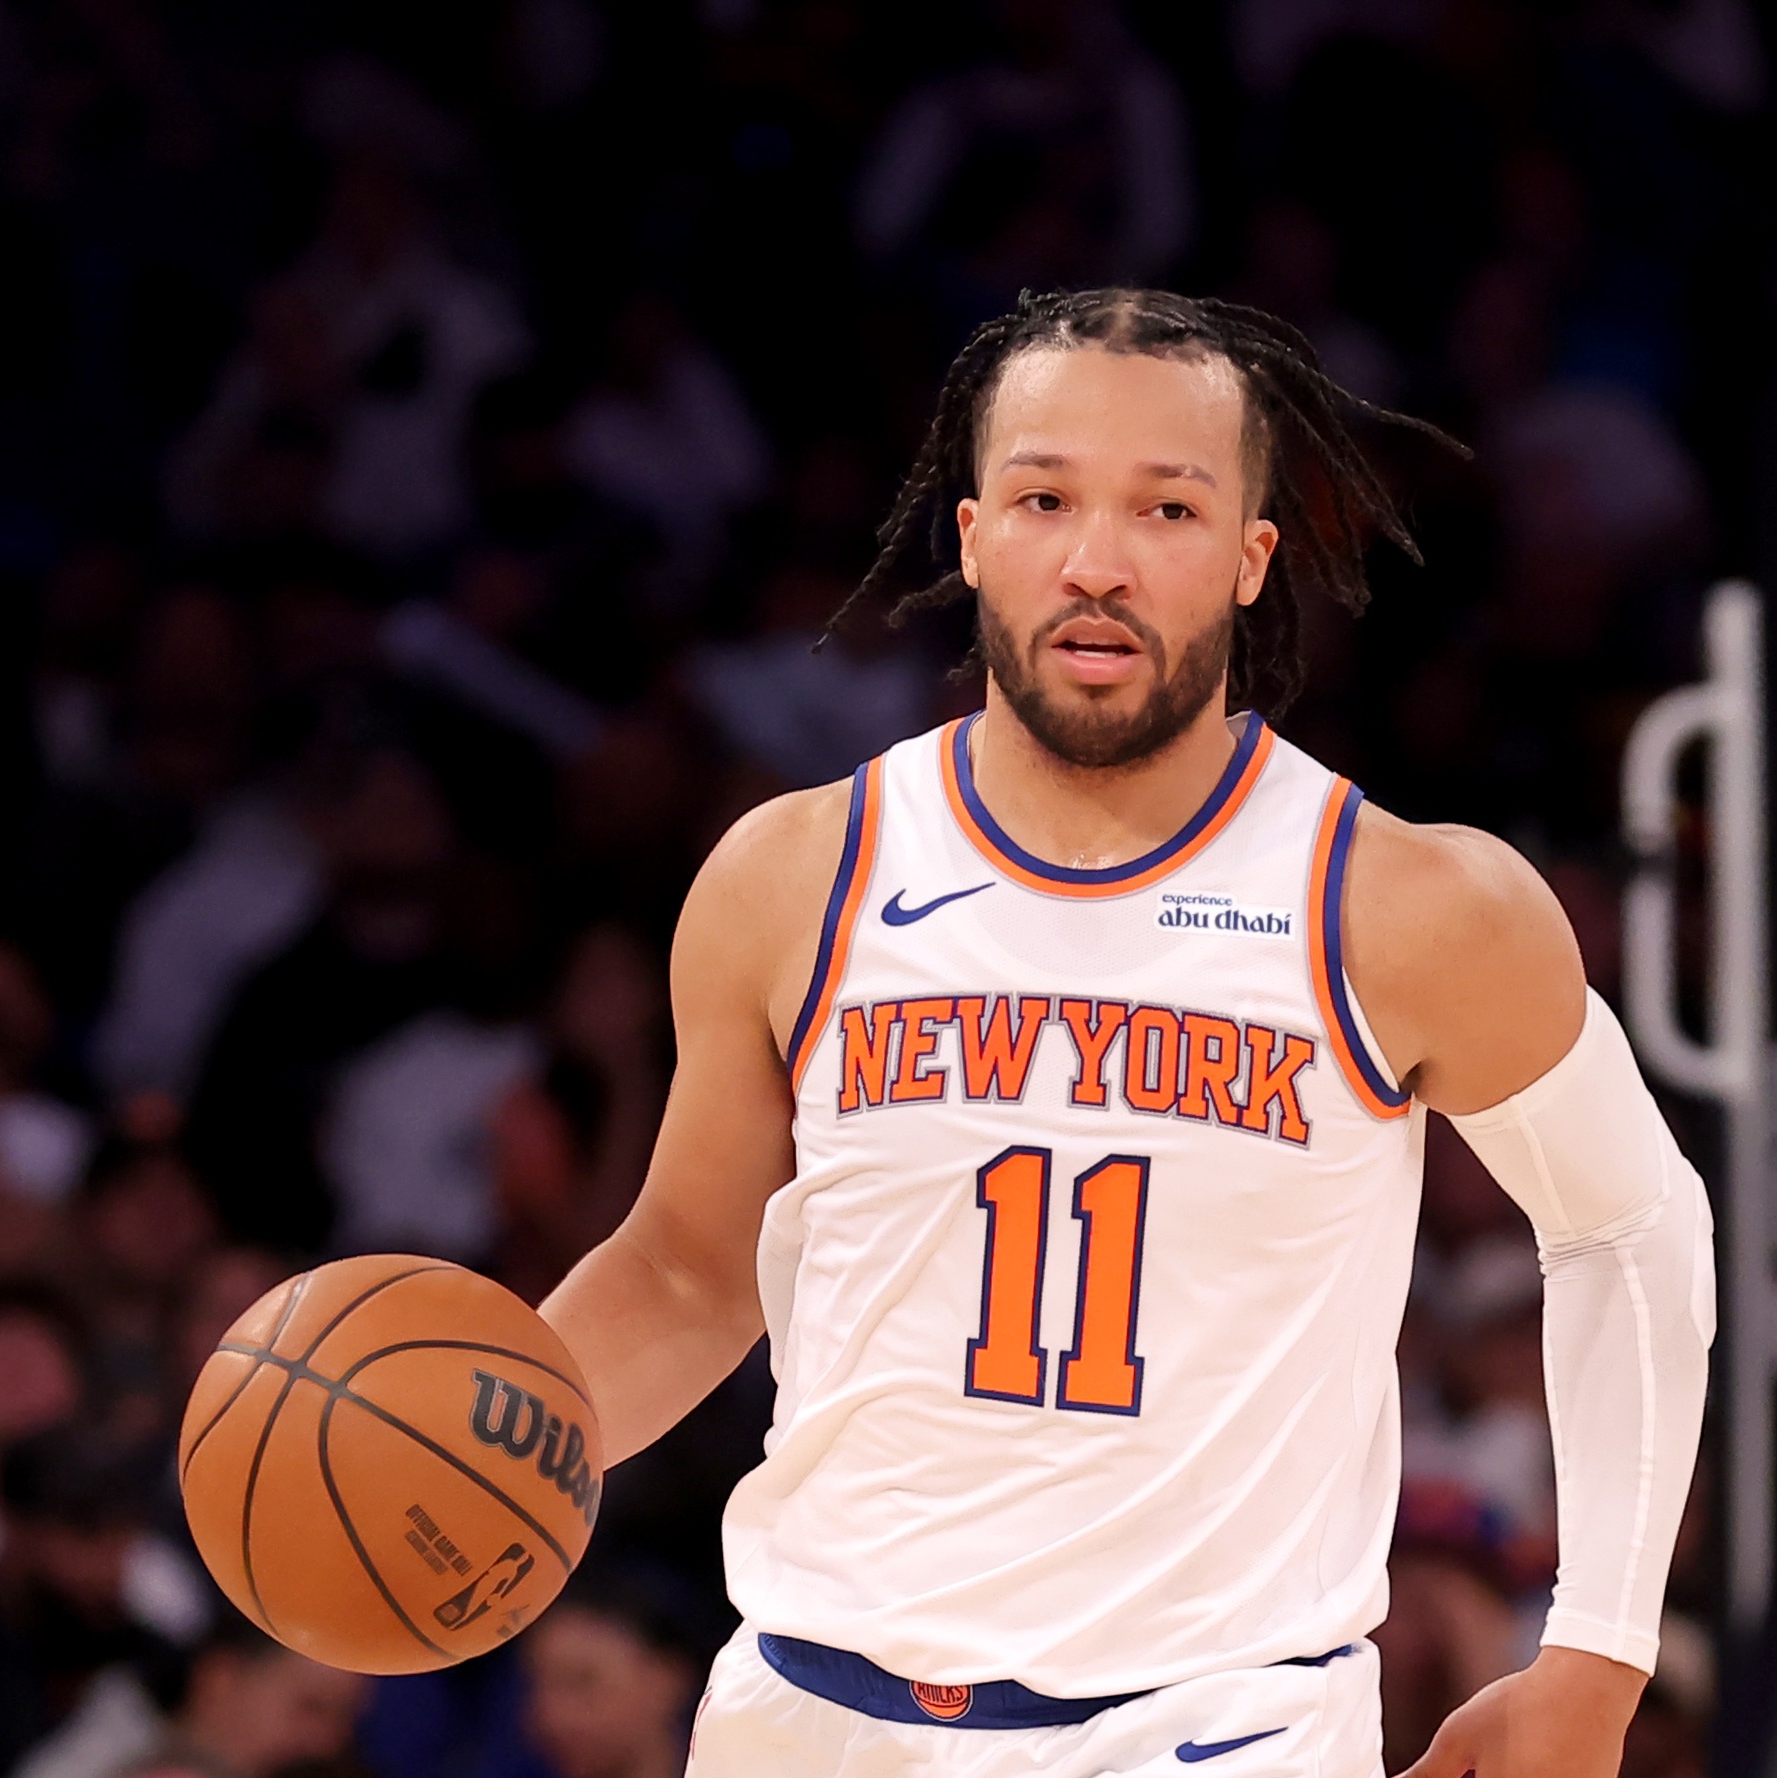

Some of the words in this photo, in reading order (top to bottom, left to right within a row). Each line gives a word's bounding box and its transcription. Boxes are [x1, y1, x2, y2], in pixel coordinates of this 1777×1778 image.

[1158, 906, 1209, 929] abu
[1162, 893, 1233, 906] experience
[836, 992, 1051, 1120] NEW
[1056, 994, 1319, 1151] YORK
[963, 1144, 1151, 1418] 11
